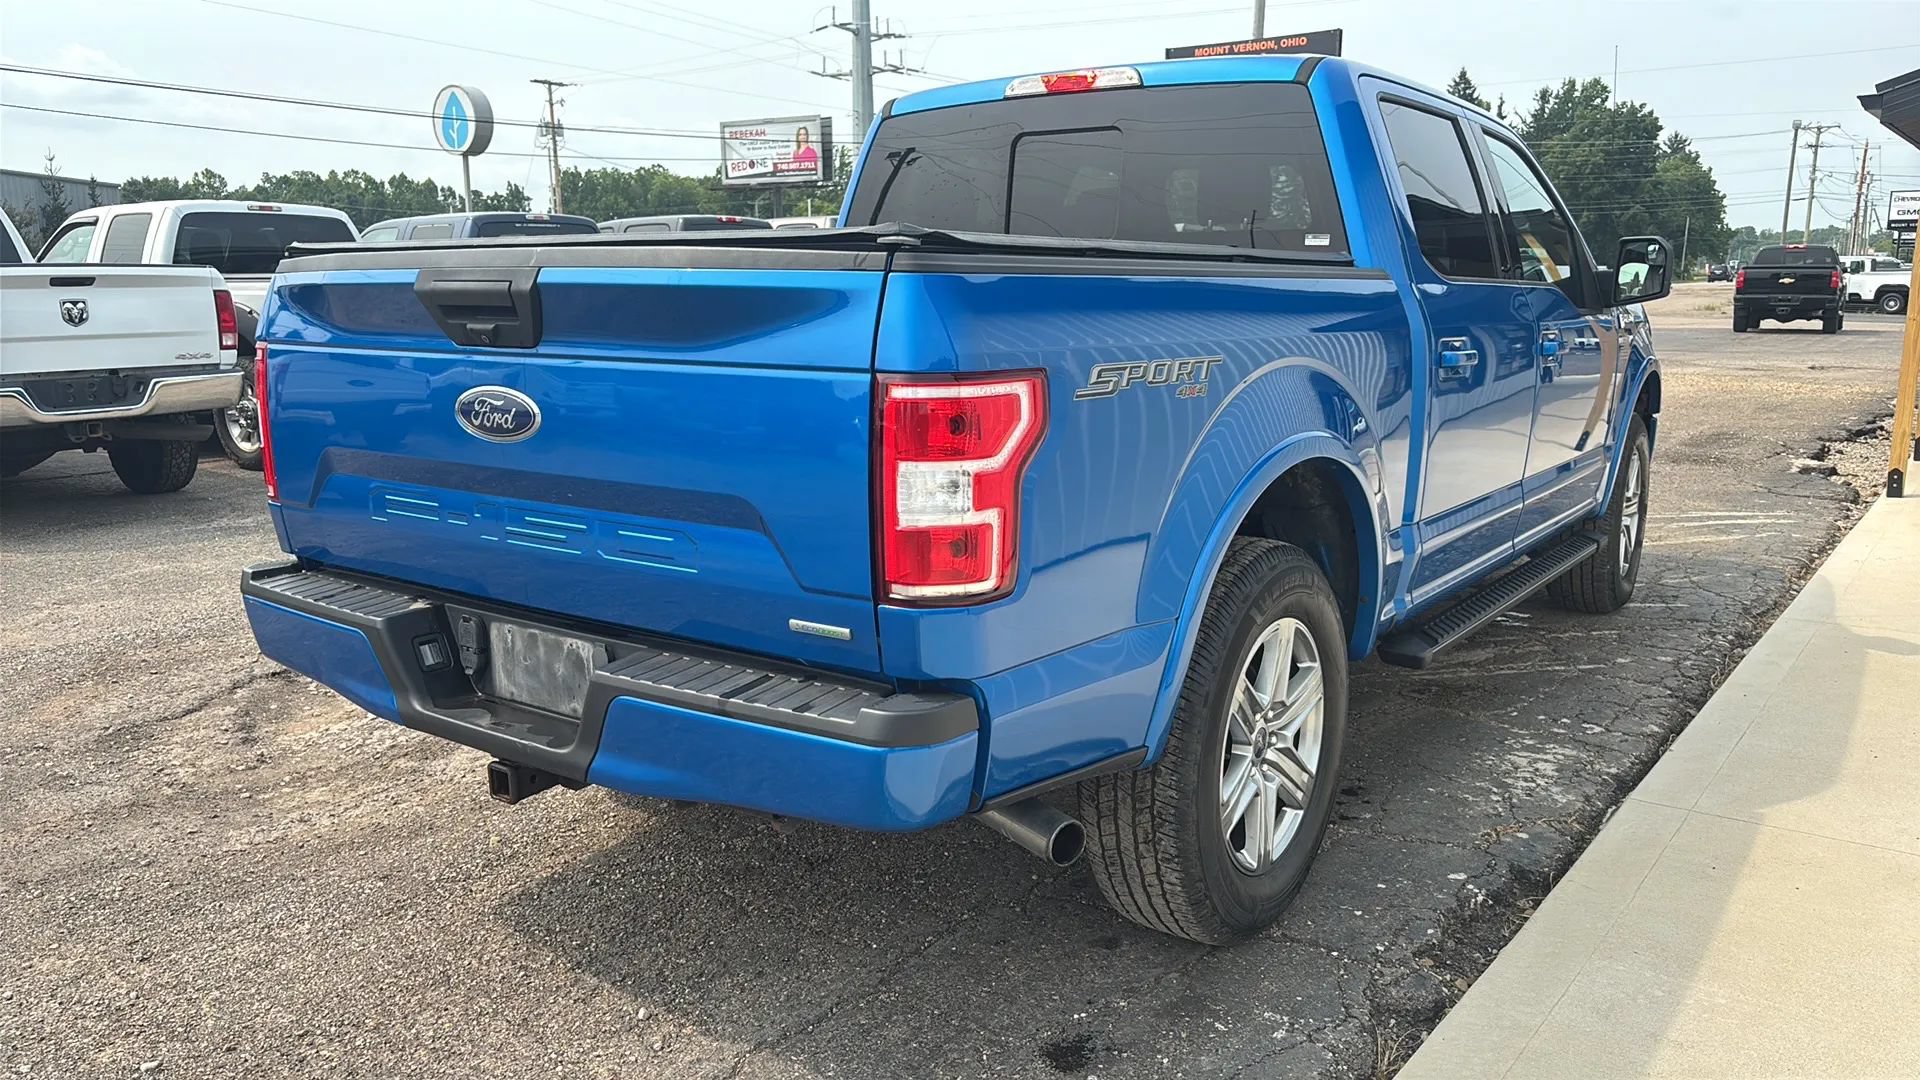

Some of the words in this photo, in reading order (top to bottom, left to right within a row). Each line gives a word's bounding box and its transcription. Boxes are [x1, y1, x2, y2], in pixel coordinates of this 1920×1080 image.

[1194, 45, 1231, 57] MOUNT
[1232, 40, 1278, 53] VERNON,
[1280, 36, 1308, 48] OHIO
[728, 128, 767, 139] REBEKAH
[1073, 355, 1224, 401] SPORT
[471, 396, 516, 430] Ford
[368, 482, 699, 573] F-150
